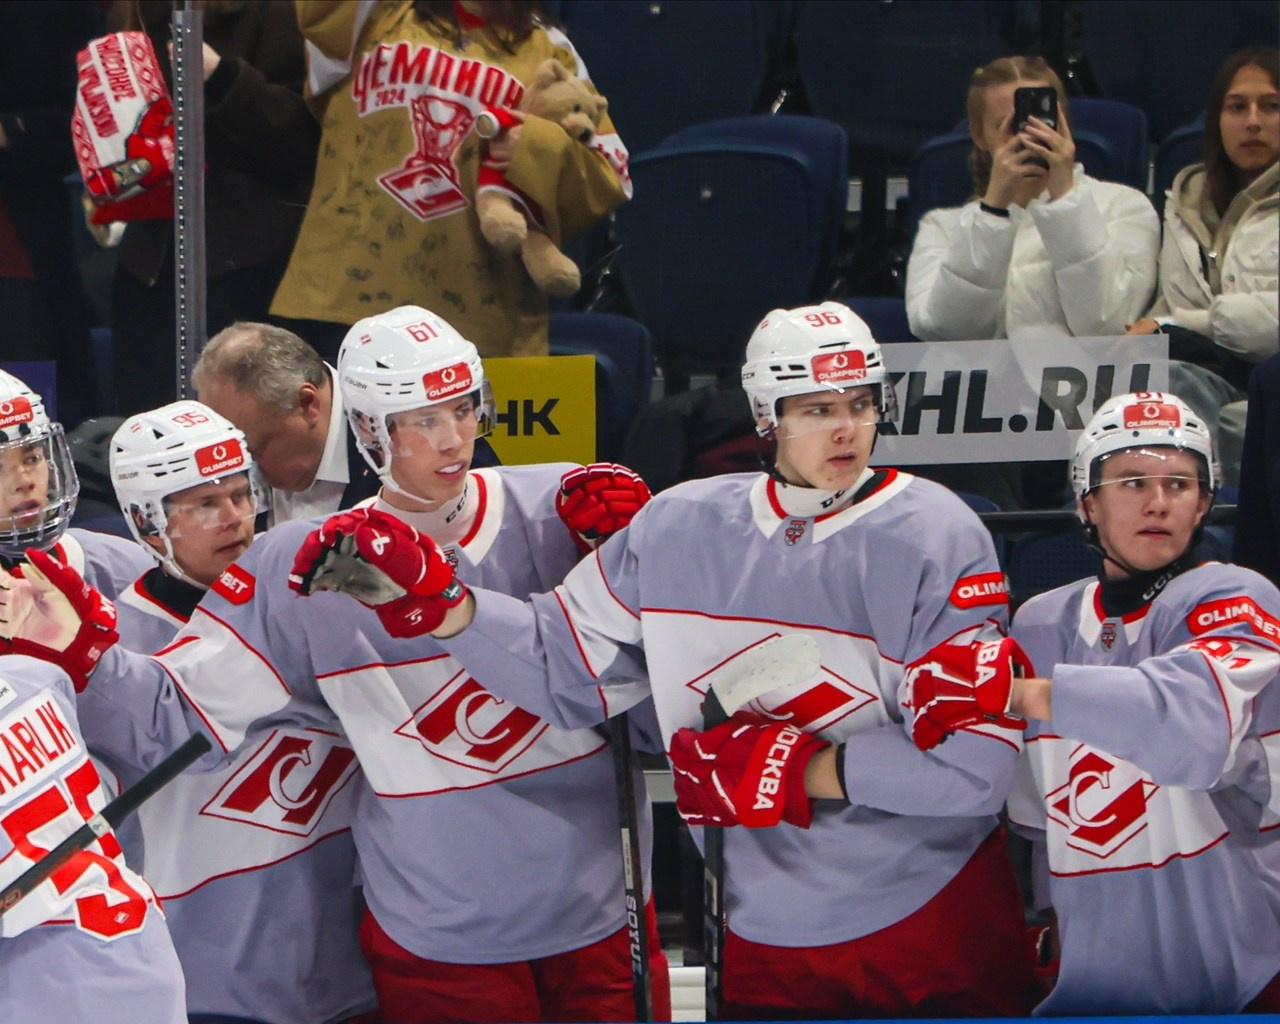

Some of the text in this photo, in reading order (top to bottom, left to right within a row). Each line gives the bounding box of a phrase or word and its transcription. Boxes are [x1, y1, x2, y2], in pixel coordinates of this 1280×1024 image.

[805, 311, 842, 328] 96
[405, 321, 439, 343] 61
[818, 368, 866, 381] OLIMPBET
[429, 378, 471, 398] OLIMPBET
[172, 411, 209, 429] 95
[477, 398, 561, 437] НК
[202, 456, 243, 475] OLIMPBET
[220, 570, 249, 595] BET
[958, 581, 1010, 599] OLIM
